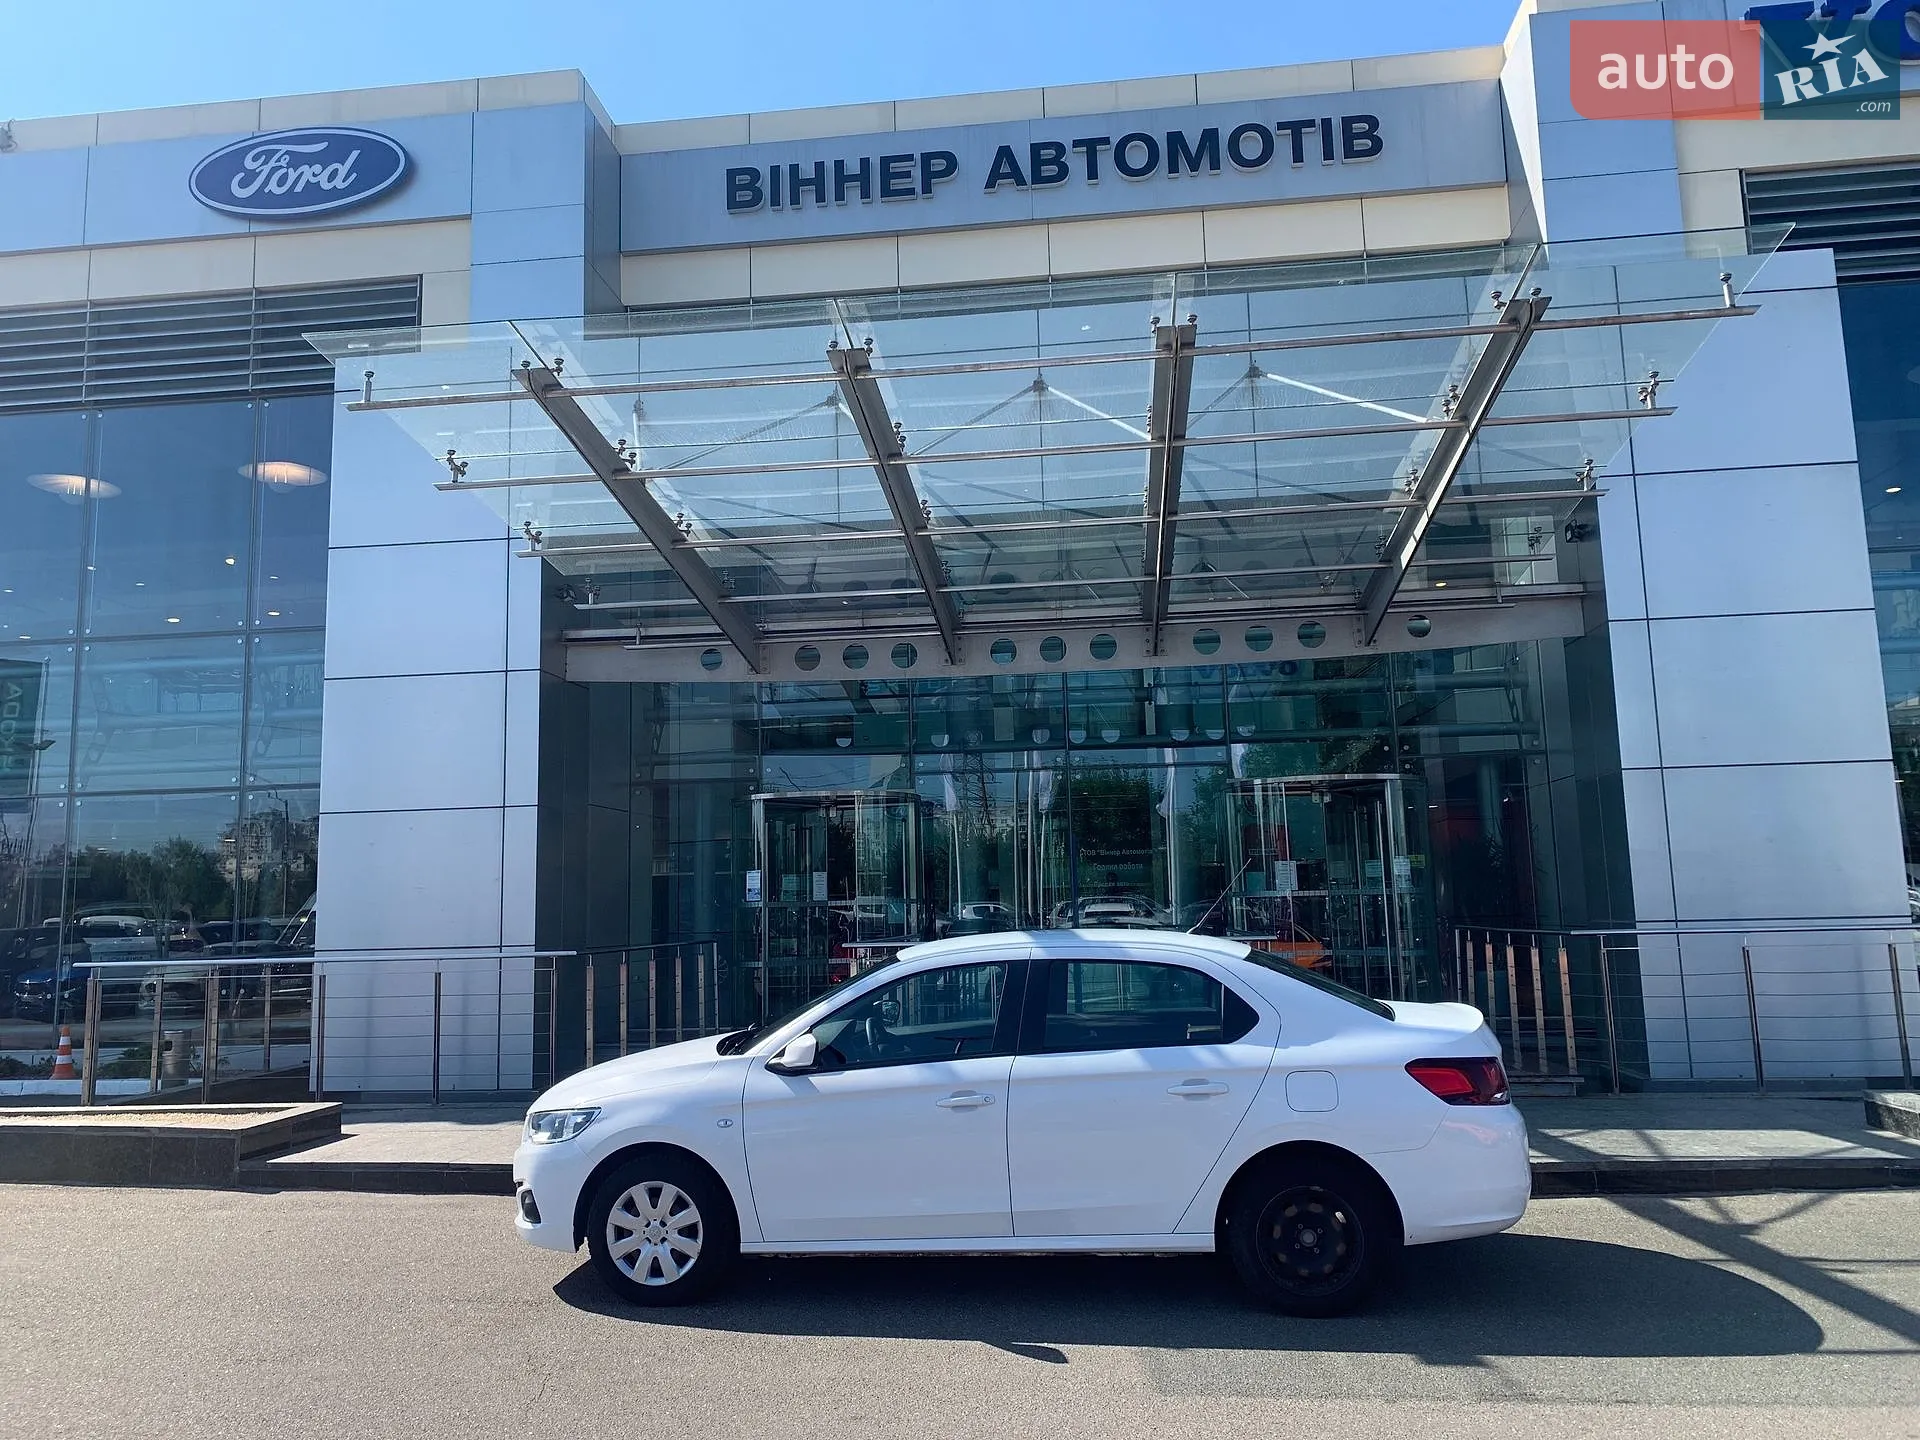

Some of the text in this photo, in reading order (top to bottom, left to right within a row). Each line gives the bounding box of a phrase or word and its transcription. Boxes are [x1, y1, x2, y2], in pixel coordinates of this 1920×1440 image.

[231, 141, 361, 199] Ford
[726, 113, 1385, 214] ВІННЕР АВТОМОТІВ
